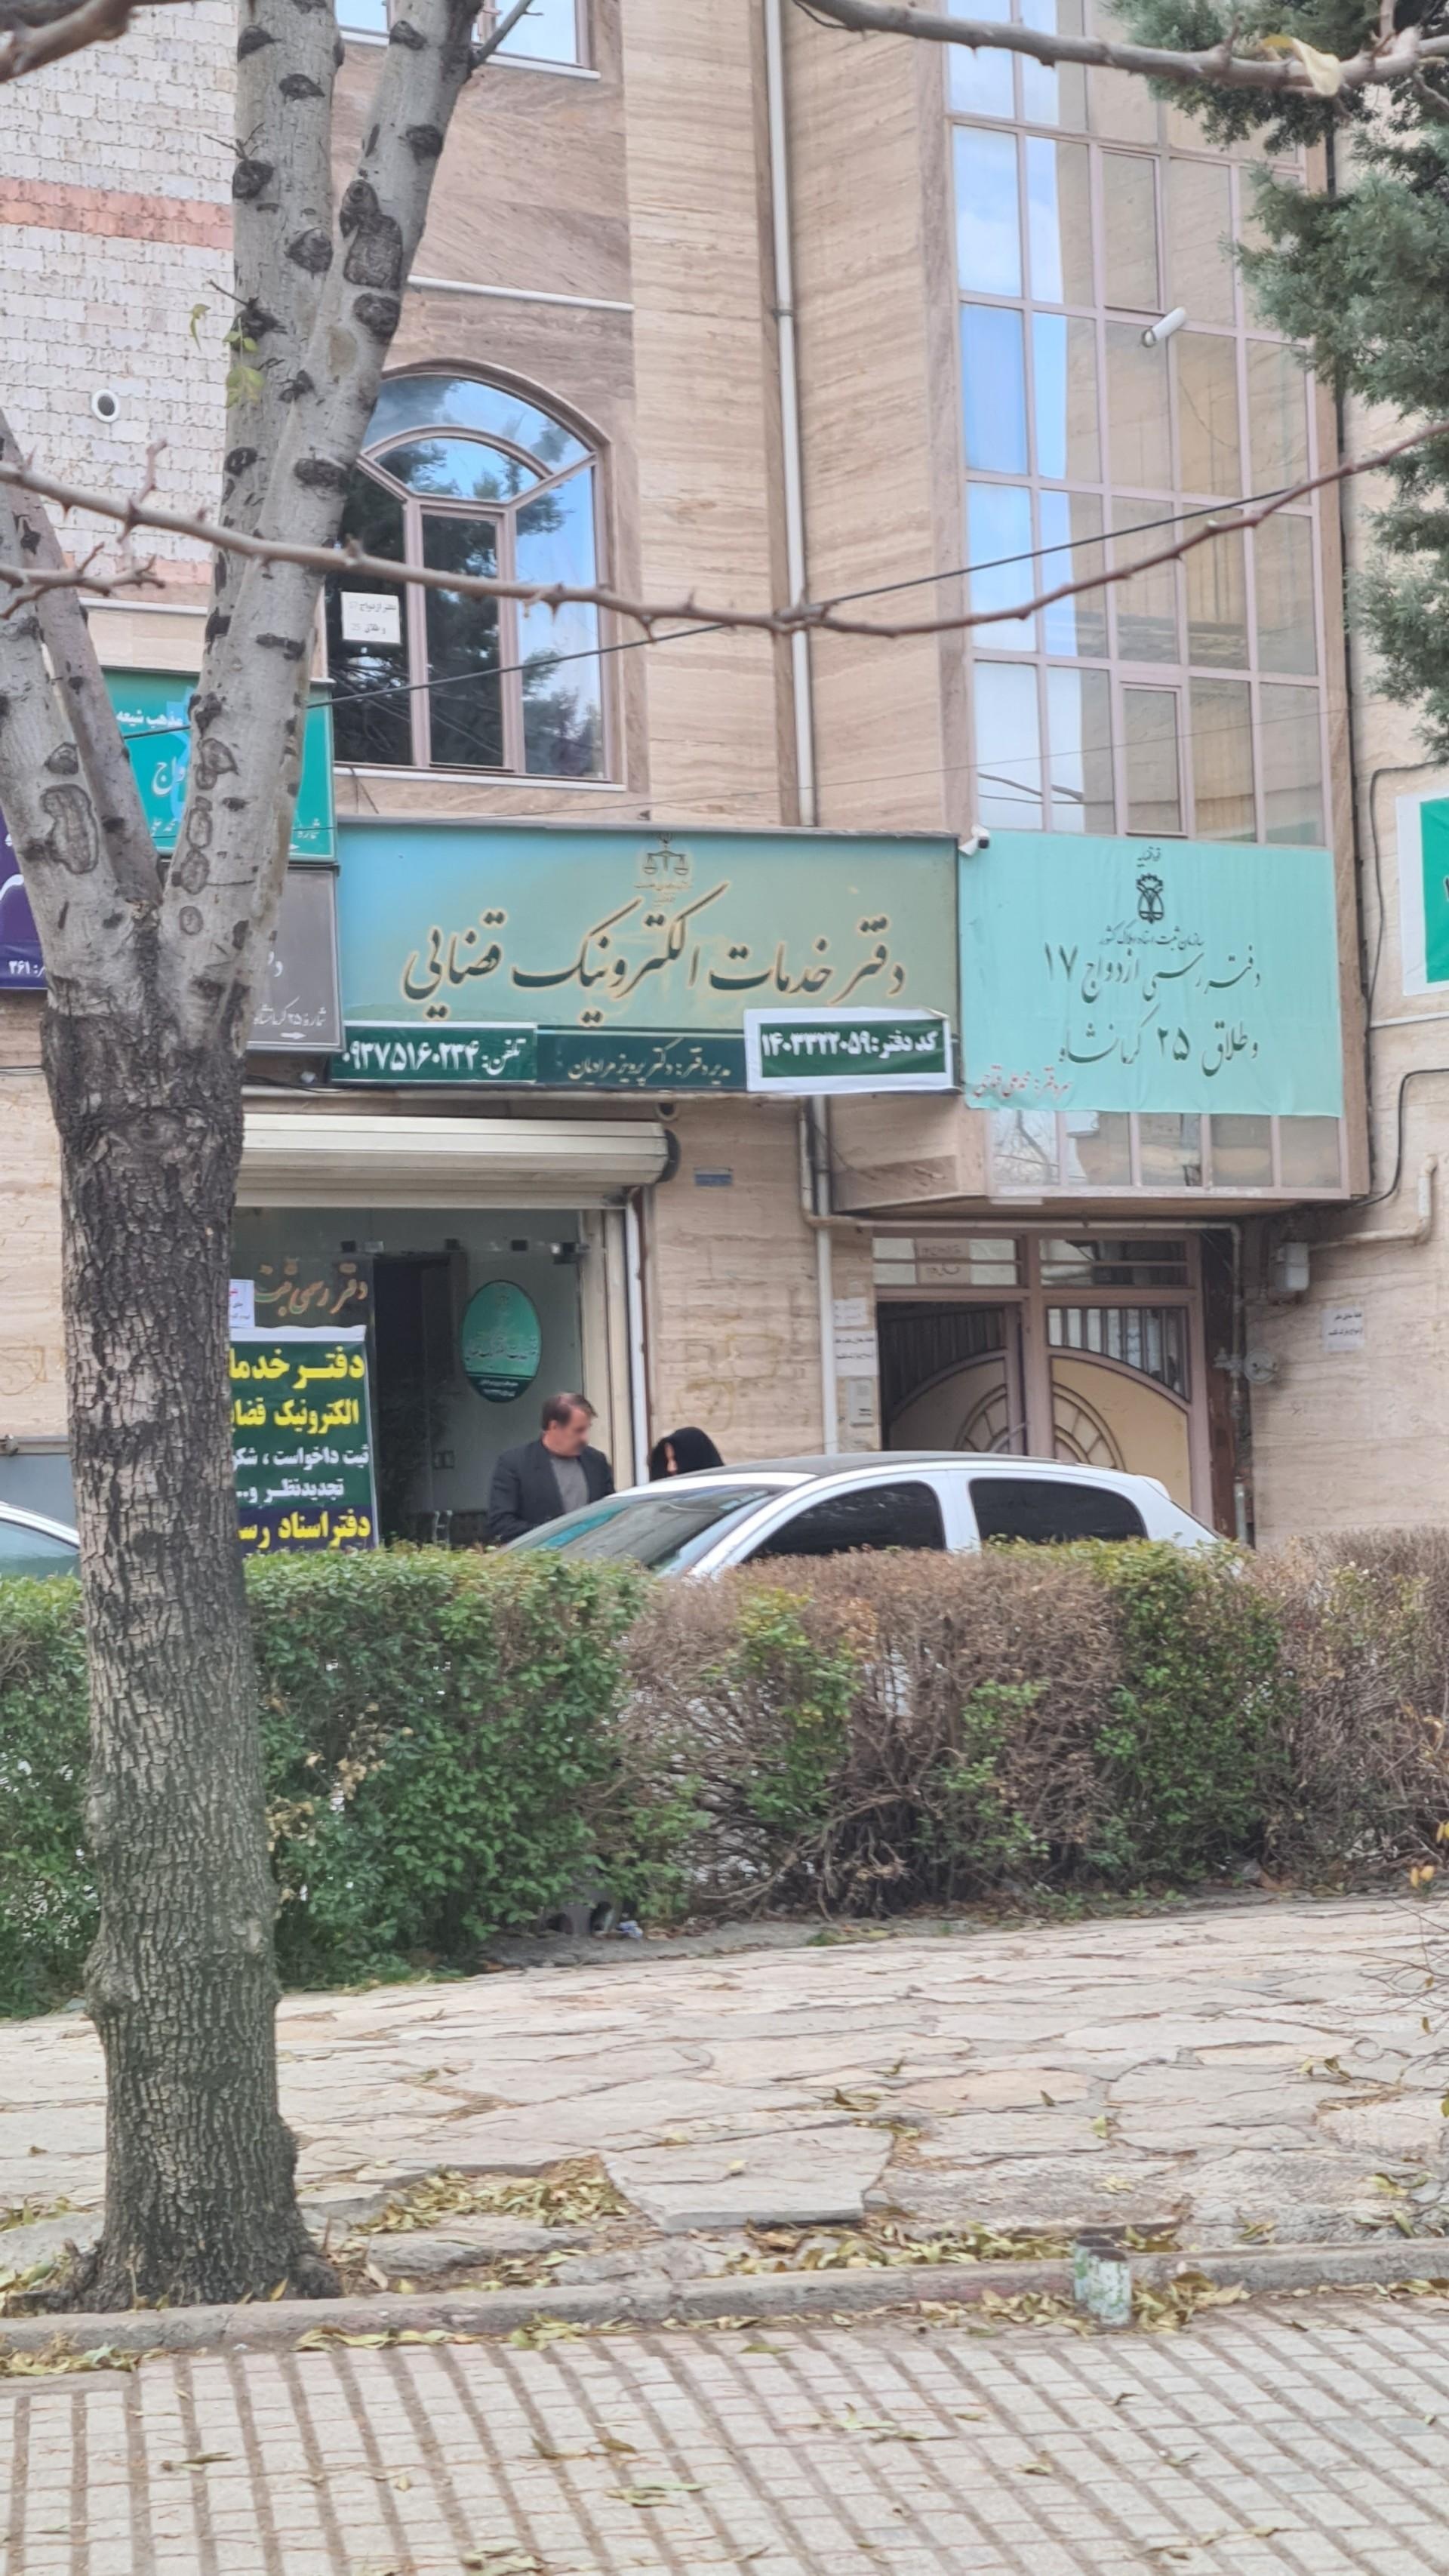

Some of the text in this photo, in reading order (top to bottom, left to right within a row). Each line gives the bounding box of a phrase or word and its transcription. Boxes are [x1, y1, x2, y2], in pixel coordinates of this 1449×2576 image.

[116, 709, 144, 727] شیعه
[512, 881, 731, 1024] الکترونیک
[709, 937, 832, 994] خدمات
[830, 915, 905, 1006] دفتر
[1044, 941, 1261, 1005] دفتر رسمی ازدواج ۱۷
[915, 1030, 939, 1051] کد
[1058, 1003, 1258, 1077] و طلاق ۲۵ کرمانشاه
[289, 1280, 330, 1315] رسمی
[329, 1262, 368, 1315] دفتر
[229, 1345, 366, 1390] دفتر خدما
[273, 1398, 359, 1434] الکترونیک
[342, 1443, 370, 1469] ثبت
[264, 1477, 344, 1503] تجدیدنظر
[278, 1510, 329, 1539] اسناد
[329, 1508, 371, 1548] دفتر
